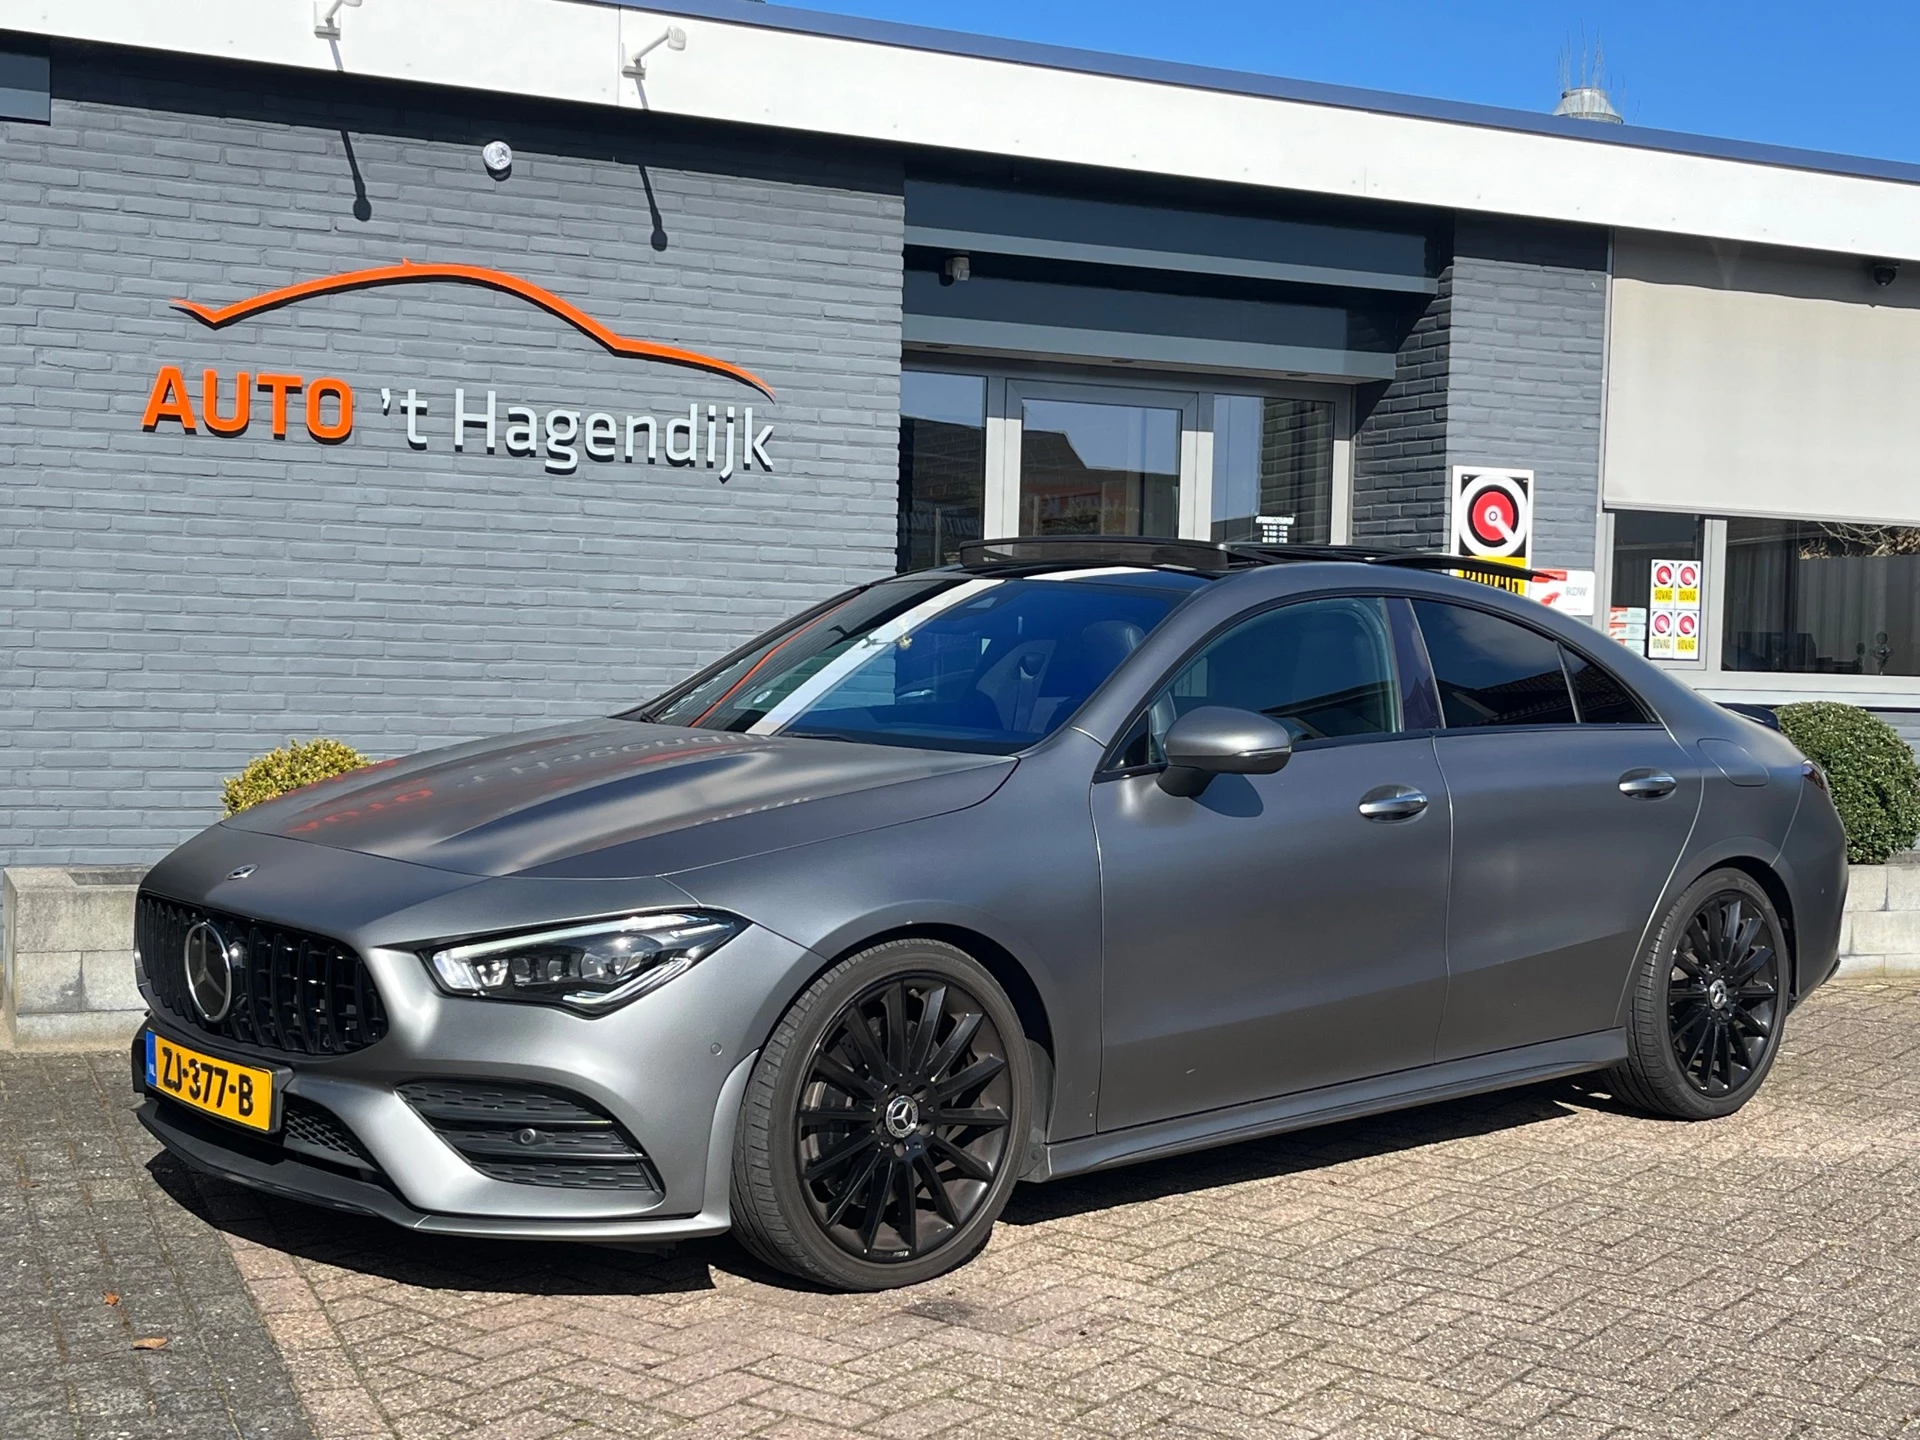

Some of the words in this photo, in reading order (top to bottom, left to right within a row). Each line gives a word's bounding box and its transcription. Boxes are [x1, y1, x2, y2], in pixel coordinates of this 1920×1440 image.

[142, 365, 352, 441] AUTO
[380, 387, 427, 446] 't
[454, 388, 775, 479] Hagendijk
[161, 1046, 254, 1117] ZJ-377-B
